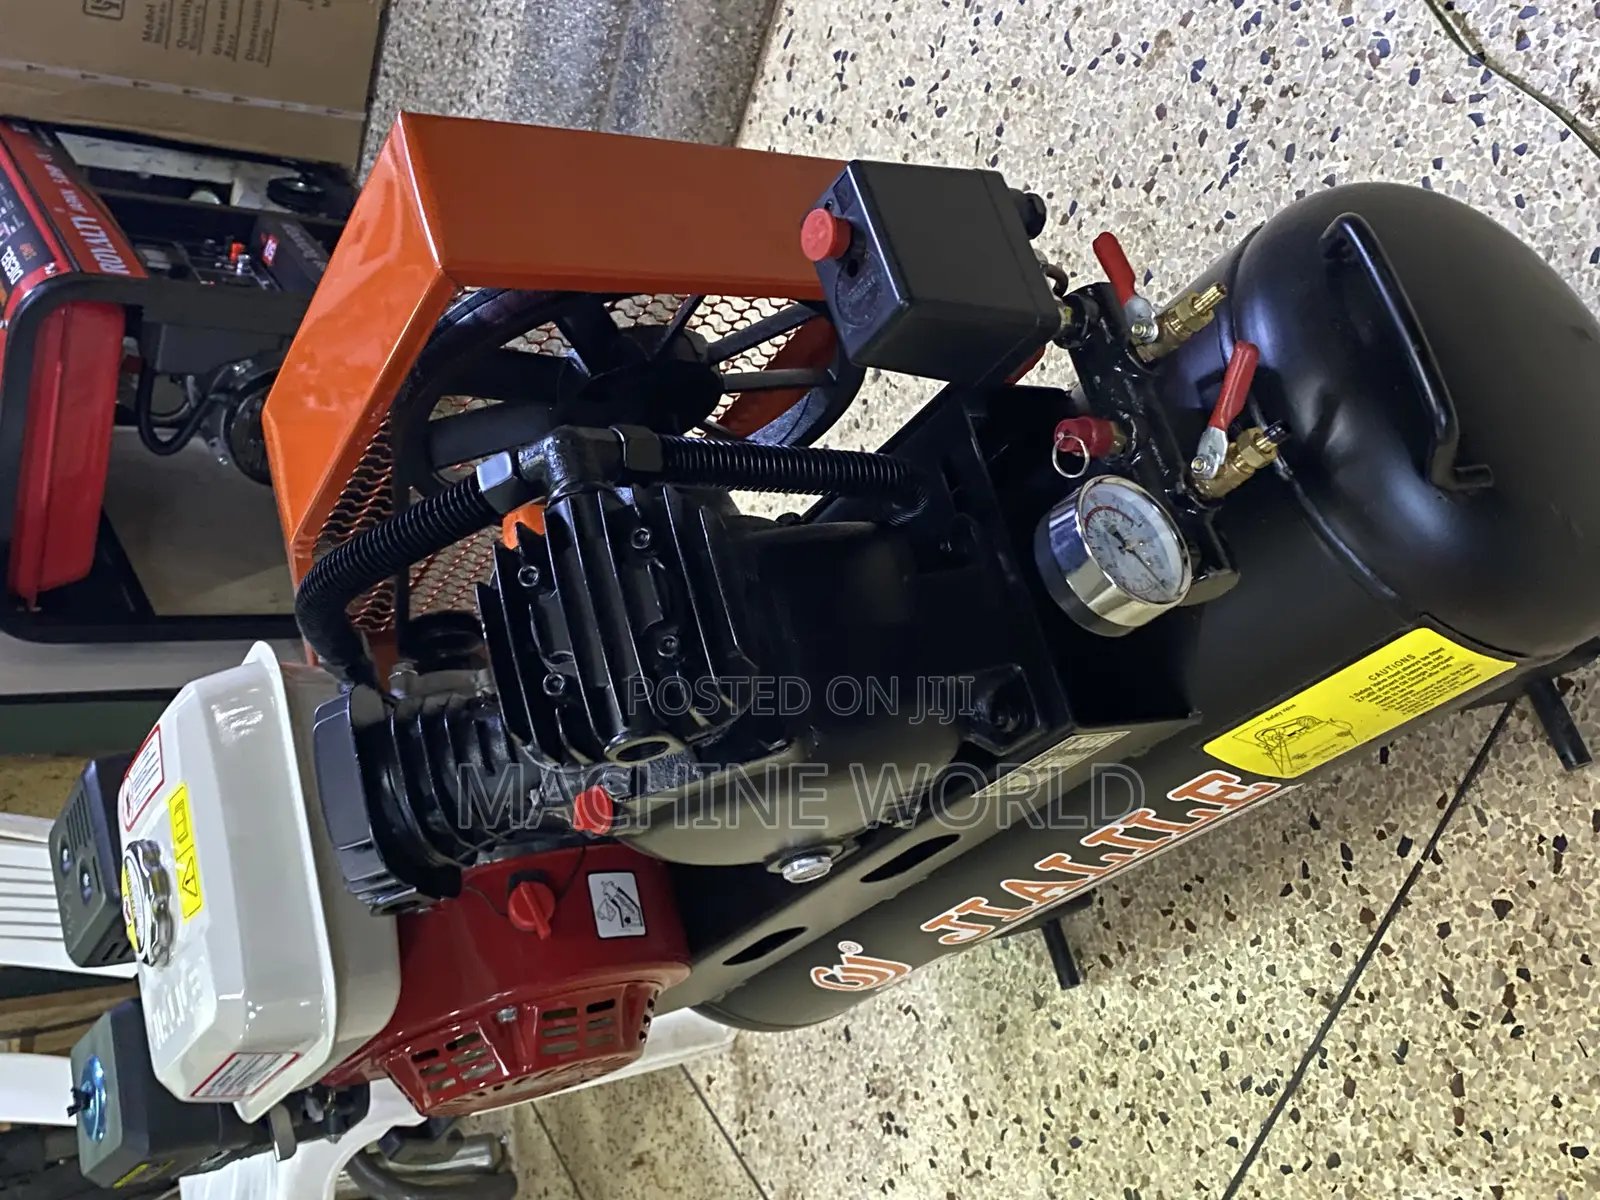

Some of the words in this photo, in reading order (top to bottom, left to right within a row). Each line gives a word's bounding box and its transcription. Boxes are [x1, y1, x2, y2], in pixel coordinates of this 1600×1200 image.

[0, 245, 24, 286] DIESEL
[71, 215, 131, 275] ROYALTY
[1368, 653, 1416, 681] CAUTIONS
